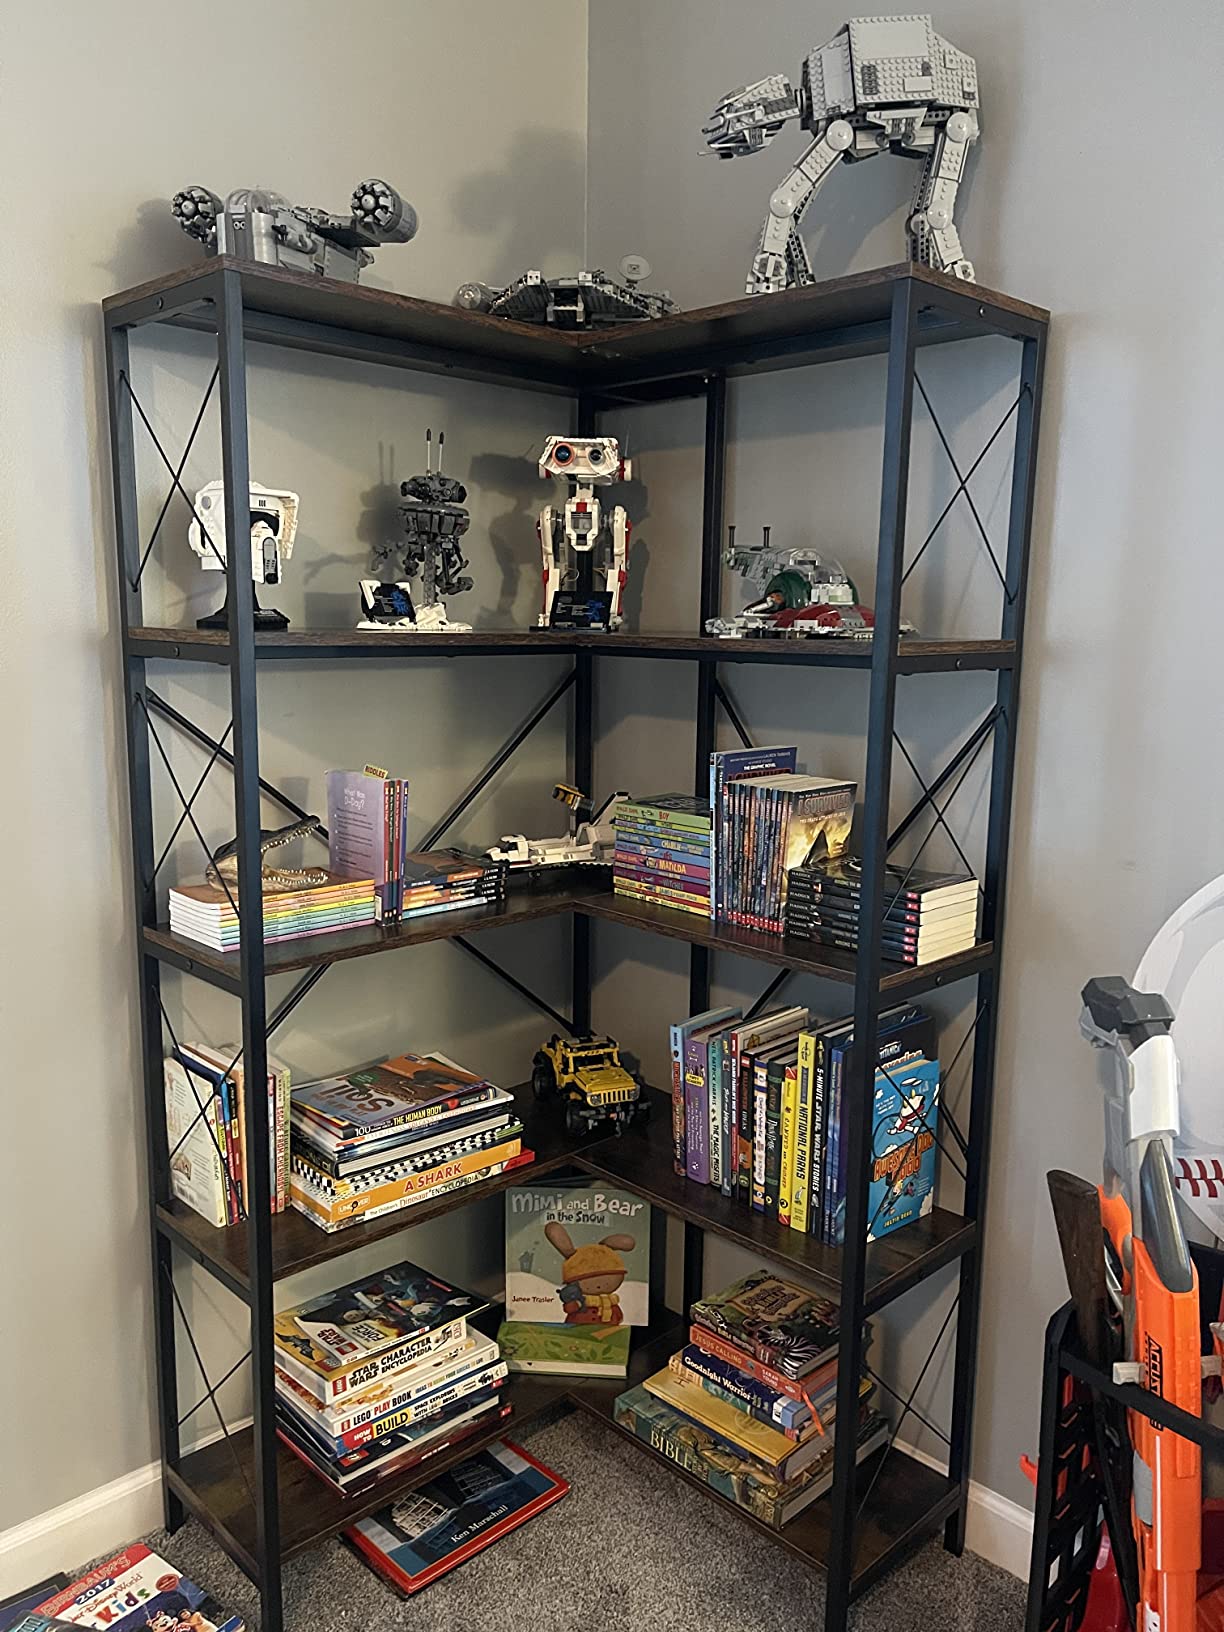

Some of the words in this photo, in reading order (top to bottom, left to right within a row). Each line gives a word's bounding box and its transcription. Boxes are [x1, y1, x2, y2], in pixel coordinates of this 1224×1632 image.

[366, 766, 386, 778] RIDDLES
[344, 796, 365, 810] D-Day?
[804, 792, 852, 816] SURVIVED
[658, 811, 670, 820] BOY
[661, 840, 682, 850] CHARLIE
[659, 860, 686, 874] MATILDA
[816, 1068, 824, 1101] 5-MINUTE
[393, 1115, 404, 1126] THE
[405, 1109, 426, 1123] HUMAN
[427, 1105, 442, 1117] BODY
[798, 1106, 808, 1147] NATIONAL
[354, 1126, 371, 1136] 100
[796, 1149, 806, 1179] PARKS
[404, 1180, 414, 1193] A
[417, 1163, 462, 1188] SHARK
[812, 1164, 820, 1191] STORIES
[370, 1208, 378, 1216] The
[400, 1190, 429, 1207] Dinosaur
[431, 1174, 479, 1196] ENCYCLOPEDIA
[566, 1198, 590, 1210] and
[593, 1194, 643, 1217] Bear
[546, 1212, 556, 1221] in
[557, 1212, 573, 1222] the
[575, 1212, 605, 1224] Snow
[884, 1217, 899, 1227] JUSTIN
[511, 1295, 530, 1304] Janee
[531, 1296, 554, 1304] Trasler
[351, 1324, 384, 1342] FORCE
[350, 1362, 379, 1380] STAR
[381, 1336, 432, 1366] CHARACTER
[696, 1334, 716, 1349] JESUS
[715, 1345, 742, 1364] CALLING
[349, 1369, 379, 1388] WARS
[381, 1345, 432, 1374] ENCYCLOPEDIA
[684, 1356, 721, 1384] Goodnight
[722, 1377, 752, 1401] Warrior
[762, 1369, 779, 1381] SARAH
[414, 1401, 429, 1411] SPACE
[429, 1388, 456, 1404] EXPLORERS
[415, 1384, 427, 1394] IDEAS
[353, 1410, 371, 1426] LEGO
[374, 1400, 391, 1416] PLAY
[392, 1391, 412, 1407] BOOK
[414, 1408, 428, 1417] WITH
[442, 1393, 458, 1404] BRICKS
[353, 1428, 371, 1441] HOW
[375, 1412, 409, 1436] BUILD
[362, 1435, 372, 1443] TO
[650, 1430, 692, 1472] BIBLE
[451, 1531, 470, 1543] Ken
[468, 1504, 509, 1532] Marschall
[40, 1553, 131, 1616] BIRNBAUM'S
[76, 1579, 112, 1604] 2017
[78, 1590, 119, 1612] Disney
[118, 1574, 143, 1594] World
[94, 1588, 150, 1624] Kids
